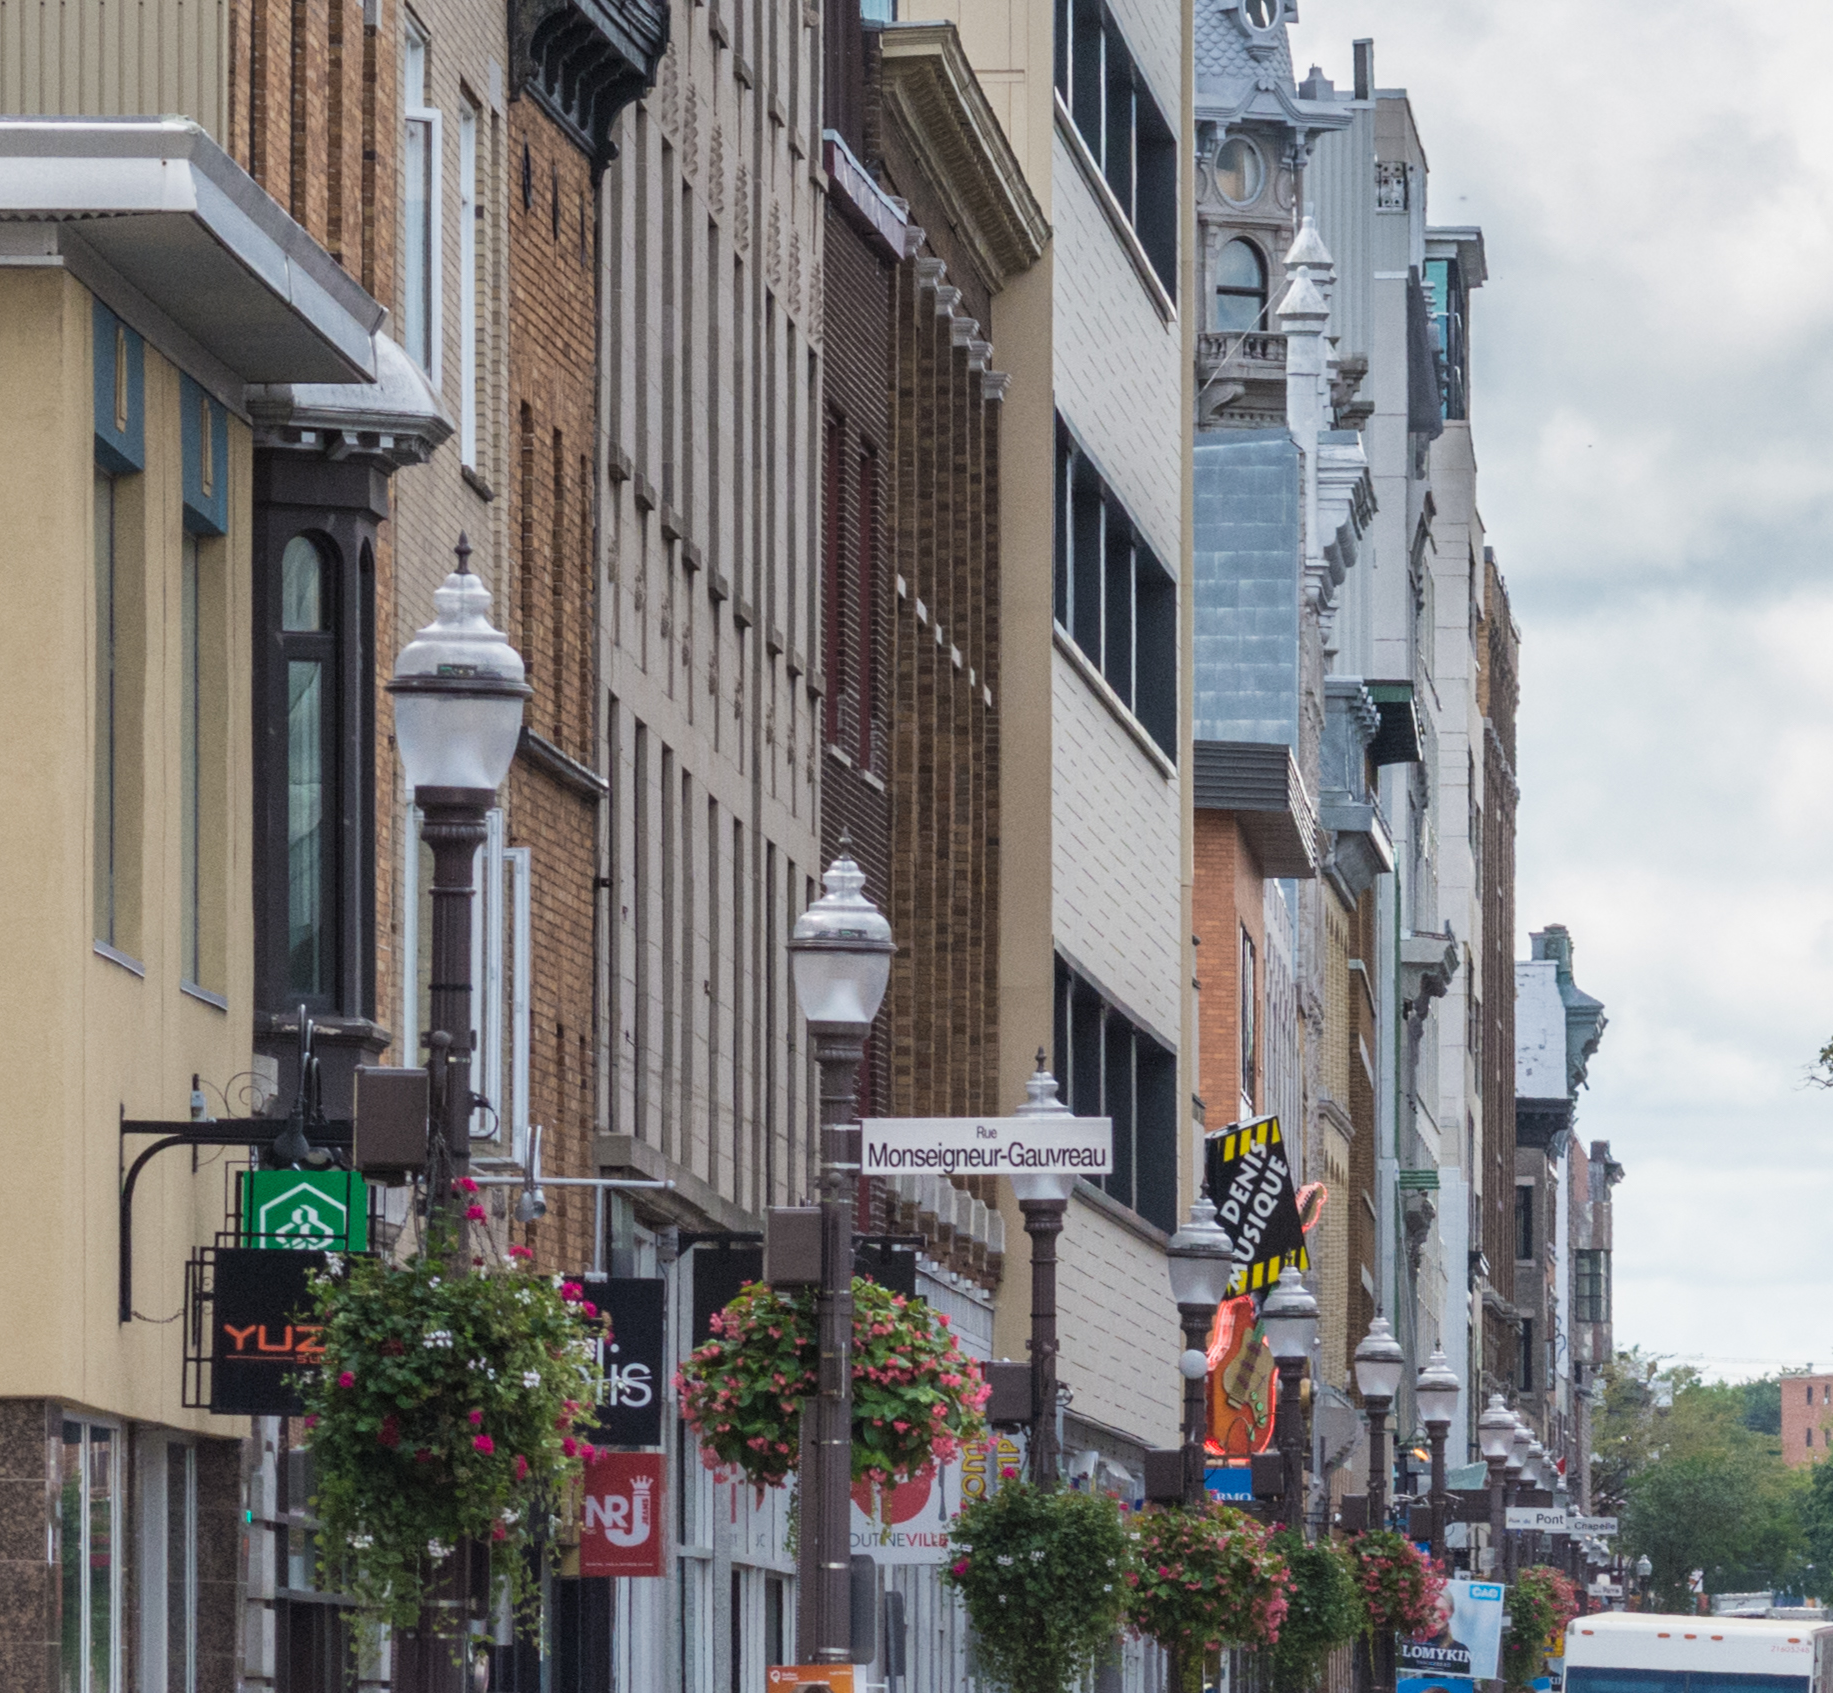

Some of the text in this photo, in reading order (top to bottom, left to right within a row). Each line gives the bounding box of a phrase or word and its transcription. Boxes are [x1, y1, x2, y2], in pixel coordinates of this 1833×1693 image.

[976, 1125, 998, 1139] Rue
[868, 1142, 1107, 1174] Monseigneur-Gauvreau
[1220, 1139, 1267, 1225] DENIS
[1228, 1155, 1289, 1291] MUSIQUE
[223, 1323, 328, 1353] YUZ
[1535, 1512, 1564, 1526] Pont
